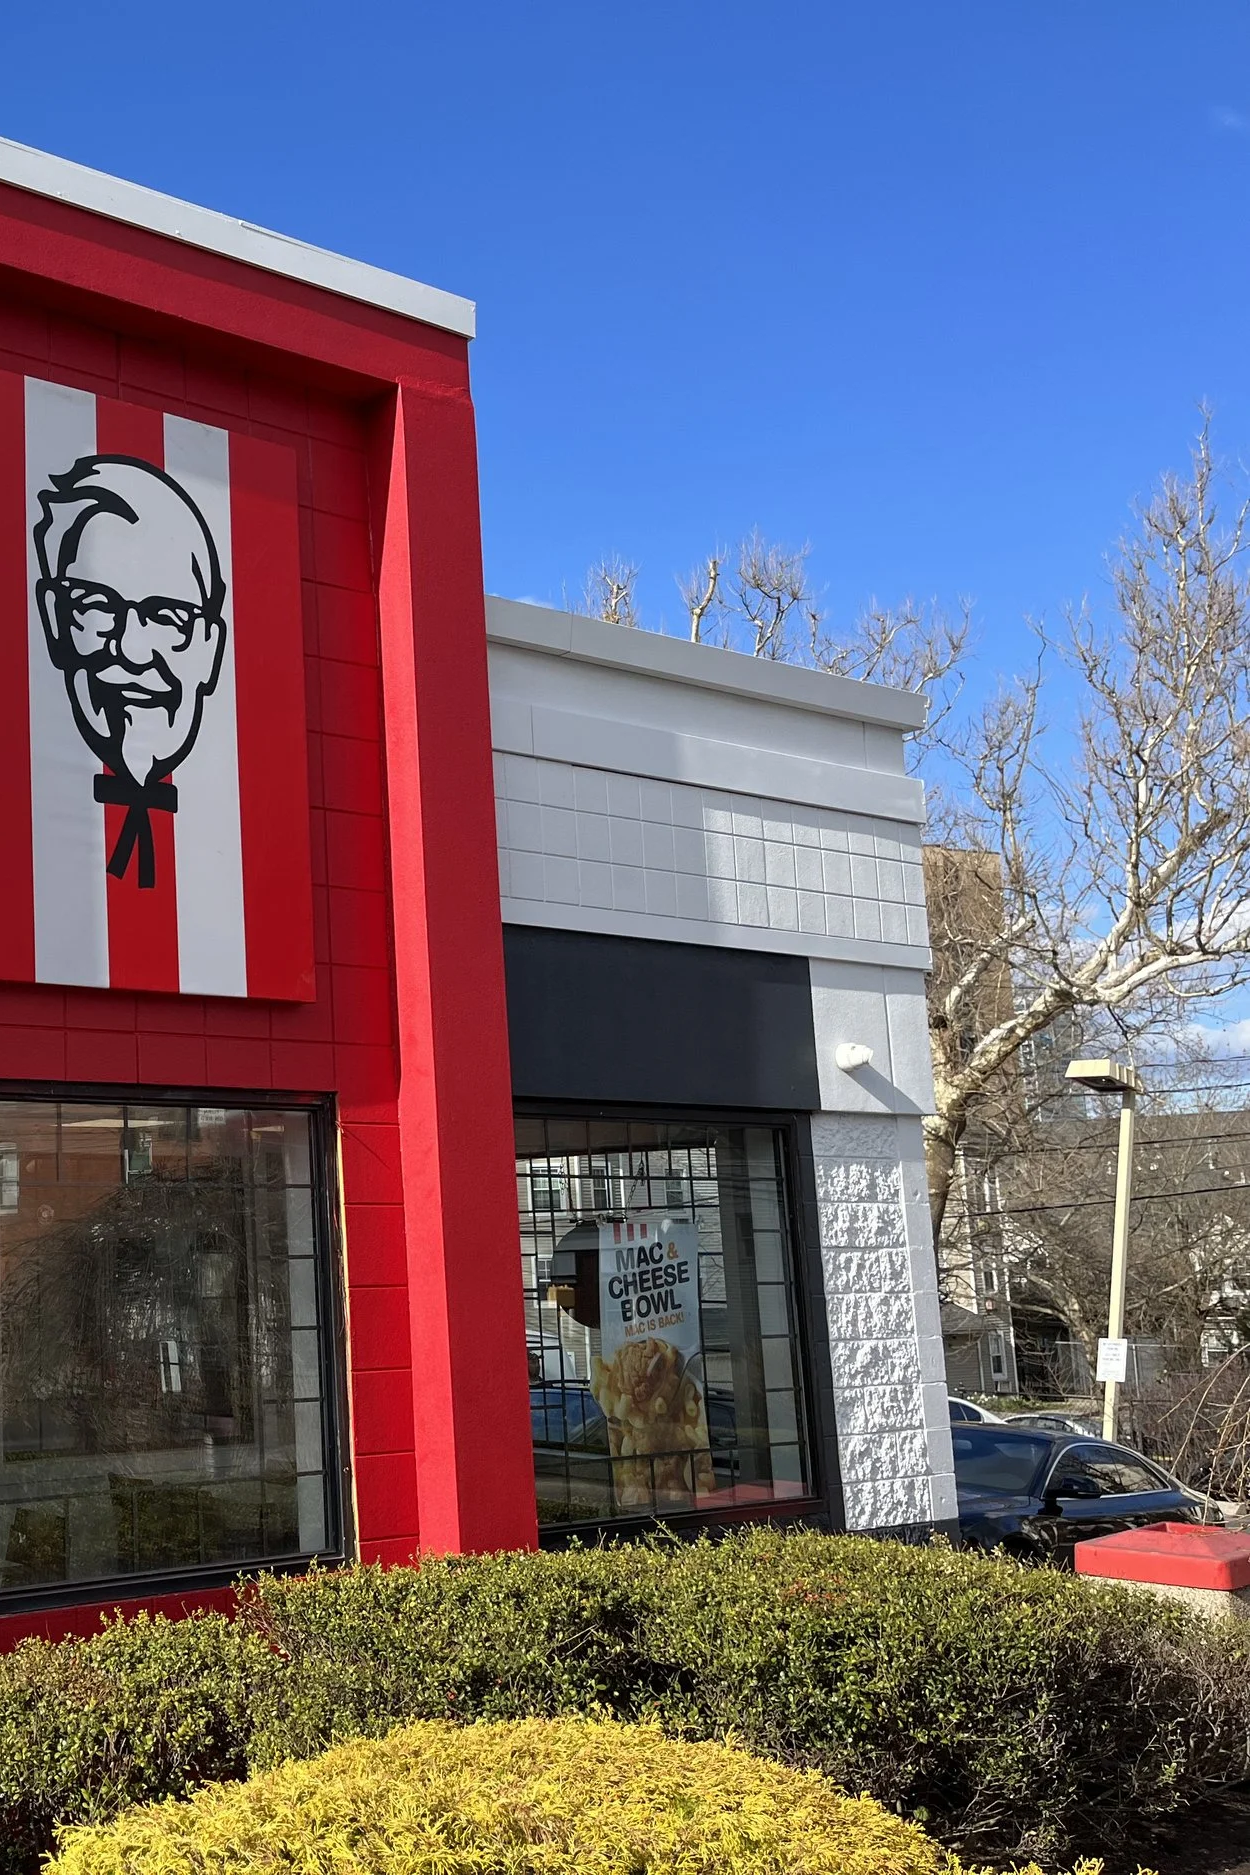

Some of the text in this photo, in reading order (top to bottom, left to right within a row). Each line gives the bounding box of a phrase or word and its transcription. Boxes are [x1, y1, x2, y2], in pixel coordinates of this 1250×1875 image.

[615, 1241, 679, 1273] MAC &
[608, 1260, 691, 1300] CHEESE
[620, 1288, 682, 1323] BOWL
[624, 1311, 685, 1338] MAC IS BACK!
